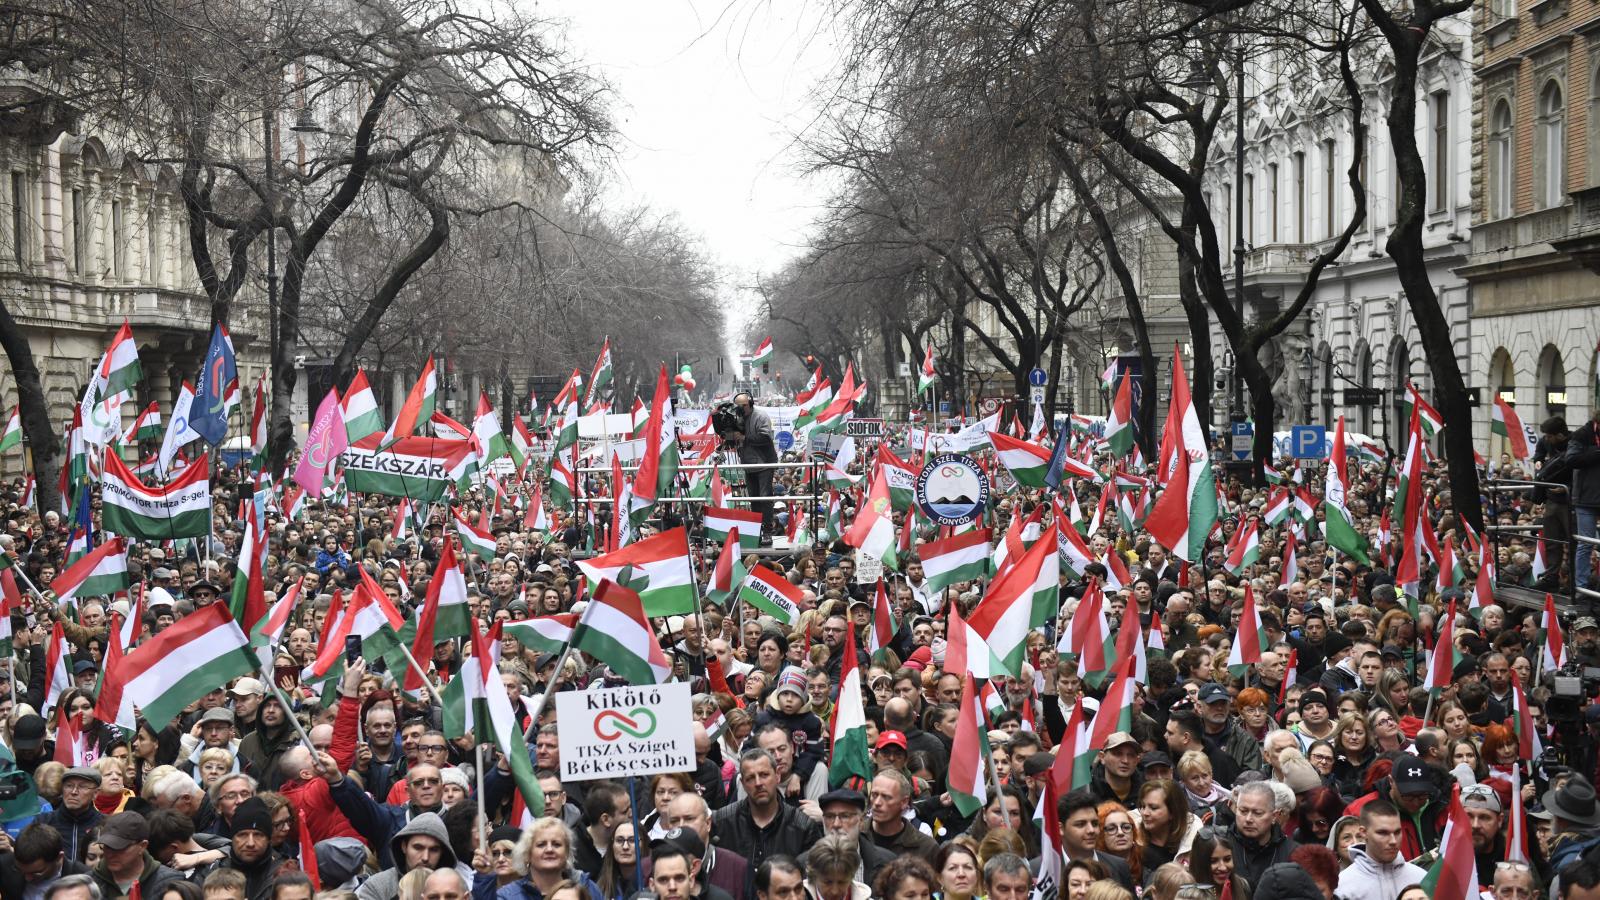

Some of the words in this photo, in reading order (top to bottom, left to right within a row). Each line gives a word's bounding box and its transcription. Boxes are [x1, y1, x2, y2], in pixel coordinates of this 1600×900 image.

[847, 421, 882, 435] SIÓFOK
[1237, 423, 1247, 434] P
[1299, 429, 1318, 454] P
[341, 453, 449, 479] SZEKSZÁR
[918, 463, 935, 505] BALATONI
[936, 454, 956, 465] SZÉL
[960, 456, 982, 475] TISZA
[978, 475, 988, 505] SZIGET
[154, 500, 179, 509] Tisza
[938, 516, 970, 526] FONYÓD
[750, 578, 768, 596] ÁRAD
[766, 590, 774, 599] A
[772, 594, 792, 613] TISZA!
[587, 688, 661, 710] Kikötő
[576, 743, 623, 758] TISZA
[628, 739, 679, 754] Sziget
[567, 753, 688, 775] Békéscsaba
